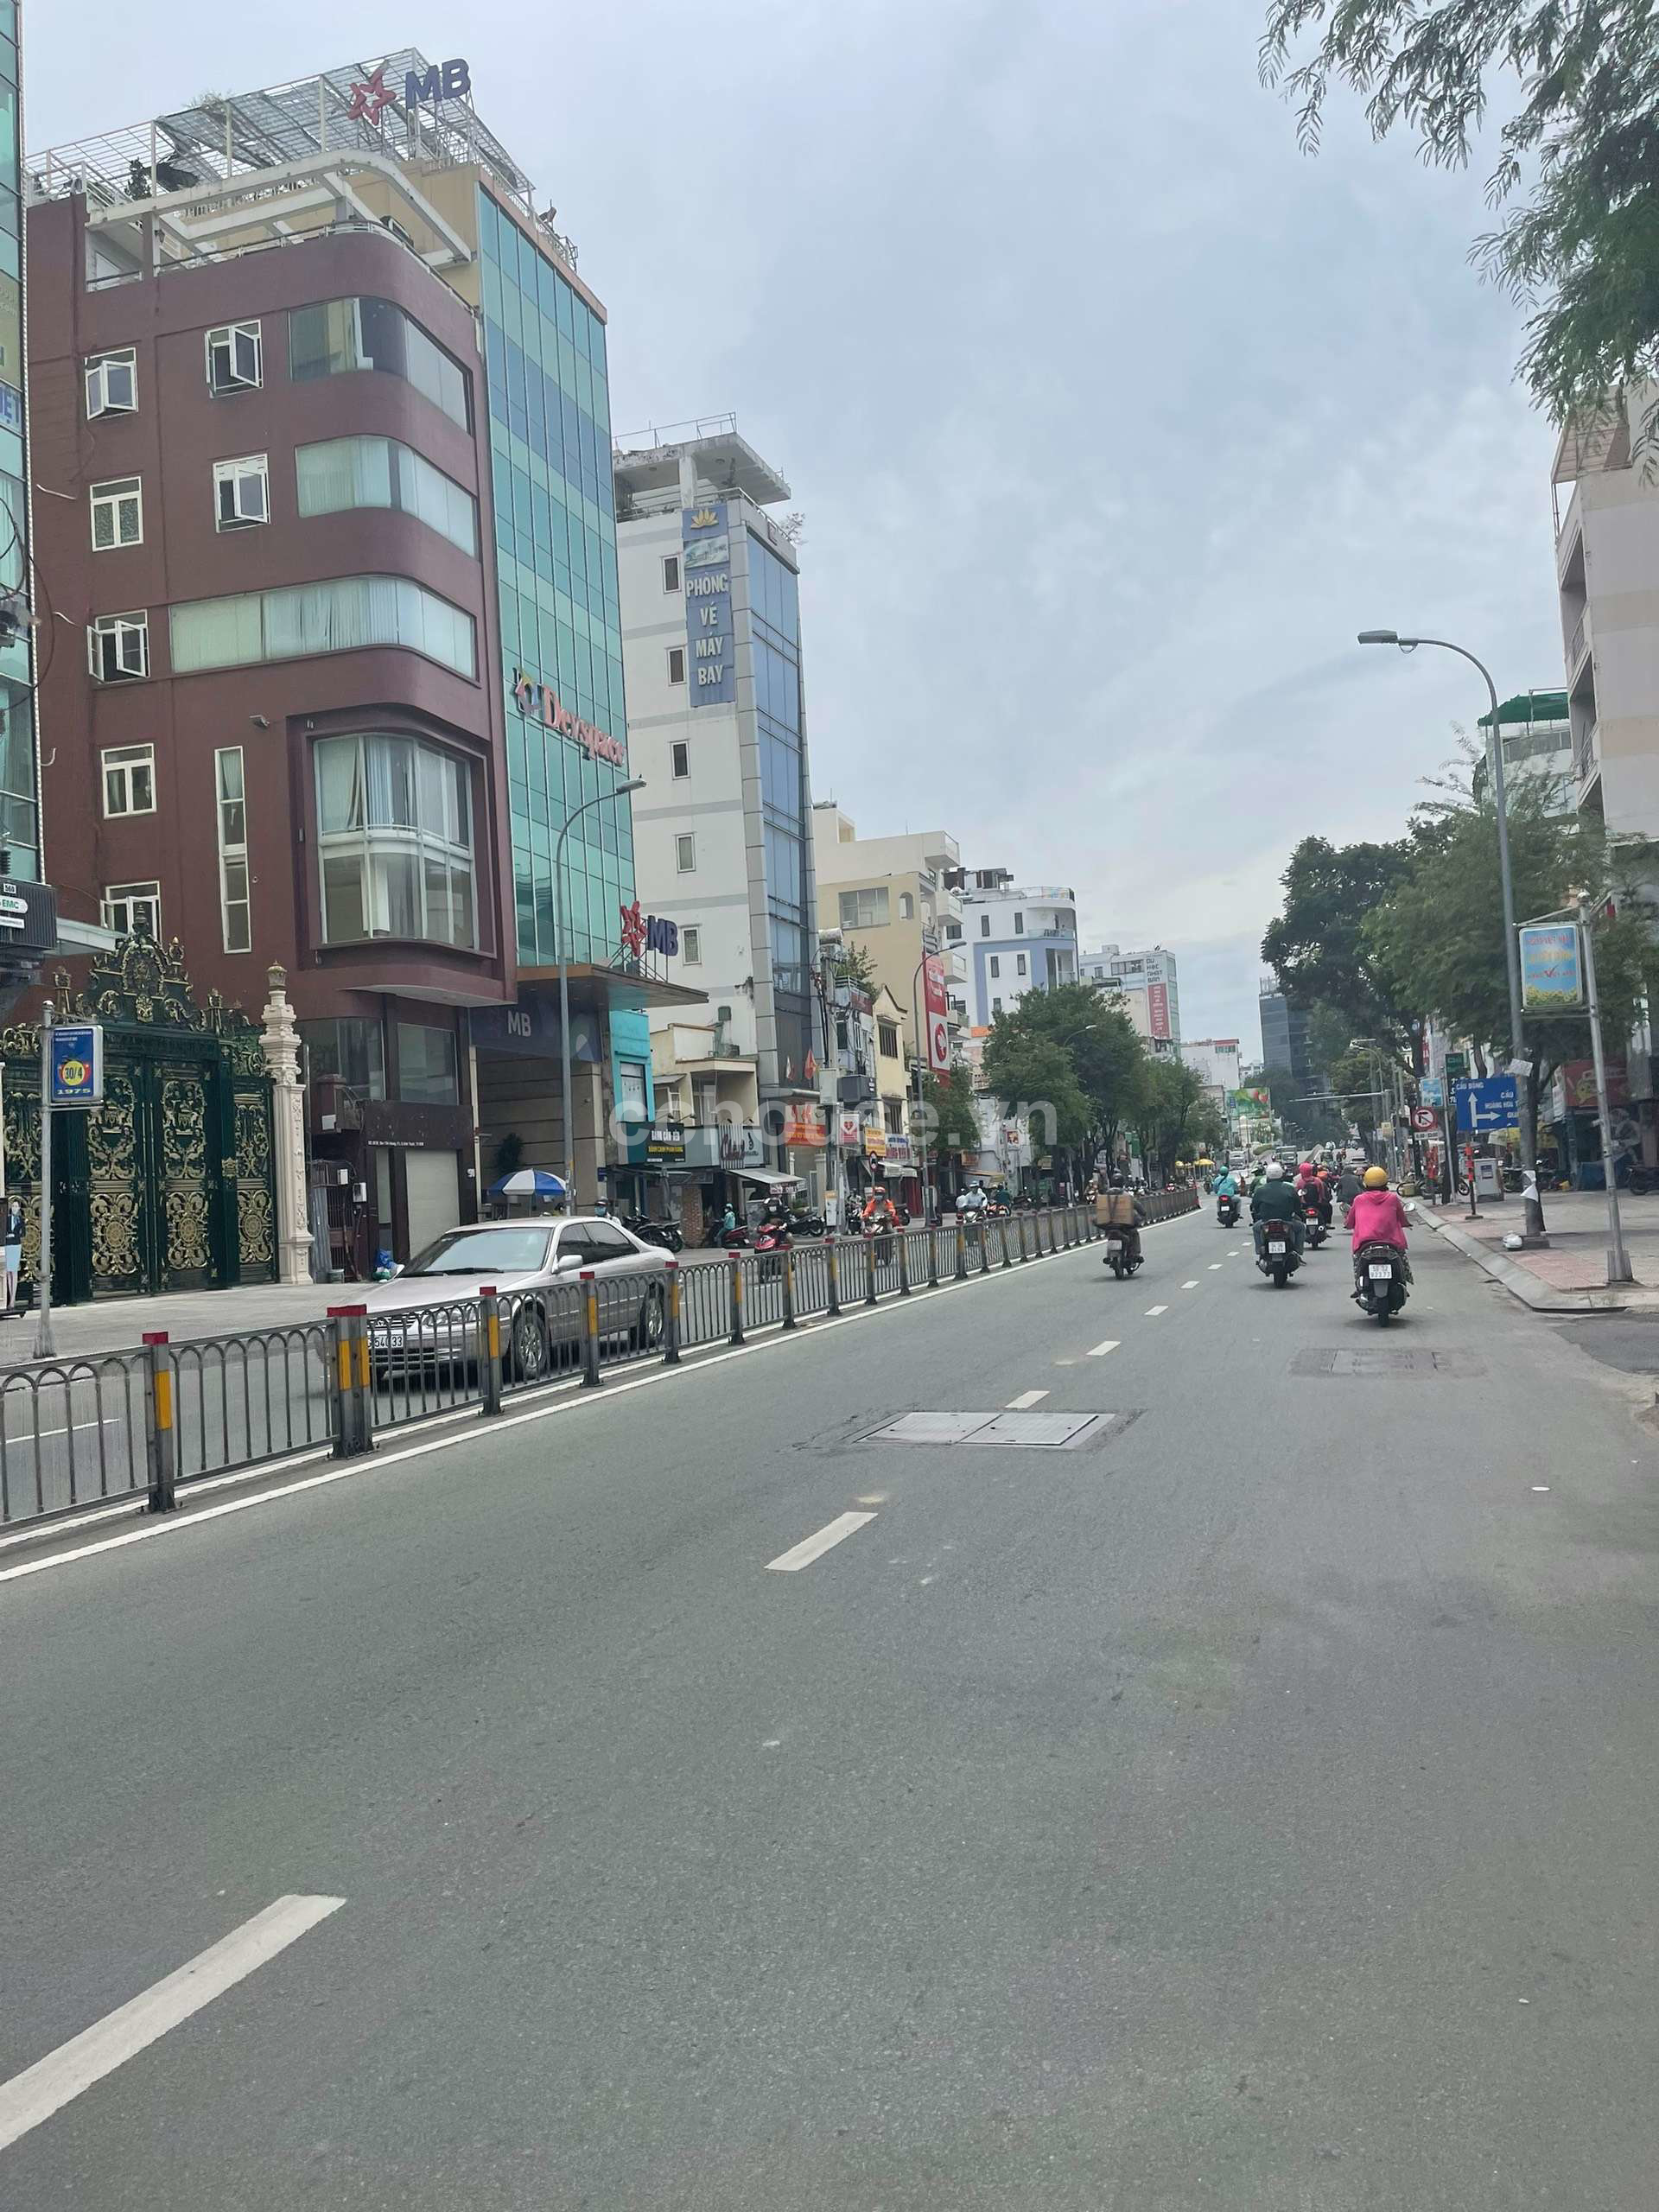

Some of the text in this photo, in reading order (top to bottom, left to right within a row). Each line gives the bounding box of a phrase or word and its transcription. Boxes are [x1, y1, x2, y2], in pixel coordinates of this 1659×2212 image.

[405, 58, 472, 109] MB
[686, 571, 729, 598] PHÒNG
[700, 601, 719, 627] VÉ
[696, 632, 724, 659] MÁY
[697, 664, 724, 687] BAY
[647, 914, 679, 957] MB
[507, 1010, 531, 1037] MB
[65, 1066, 84, 1079] 30/4
